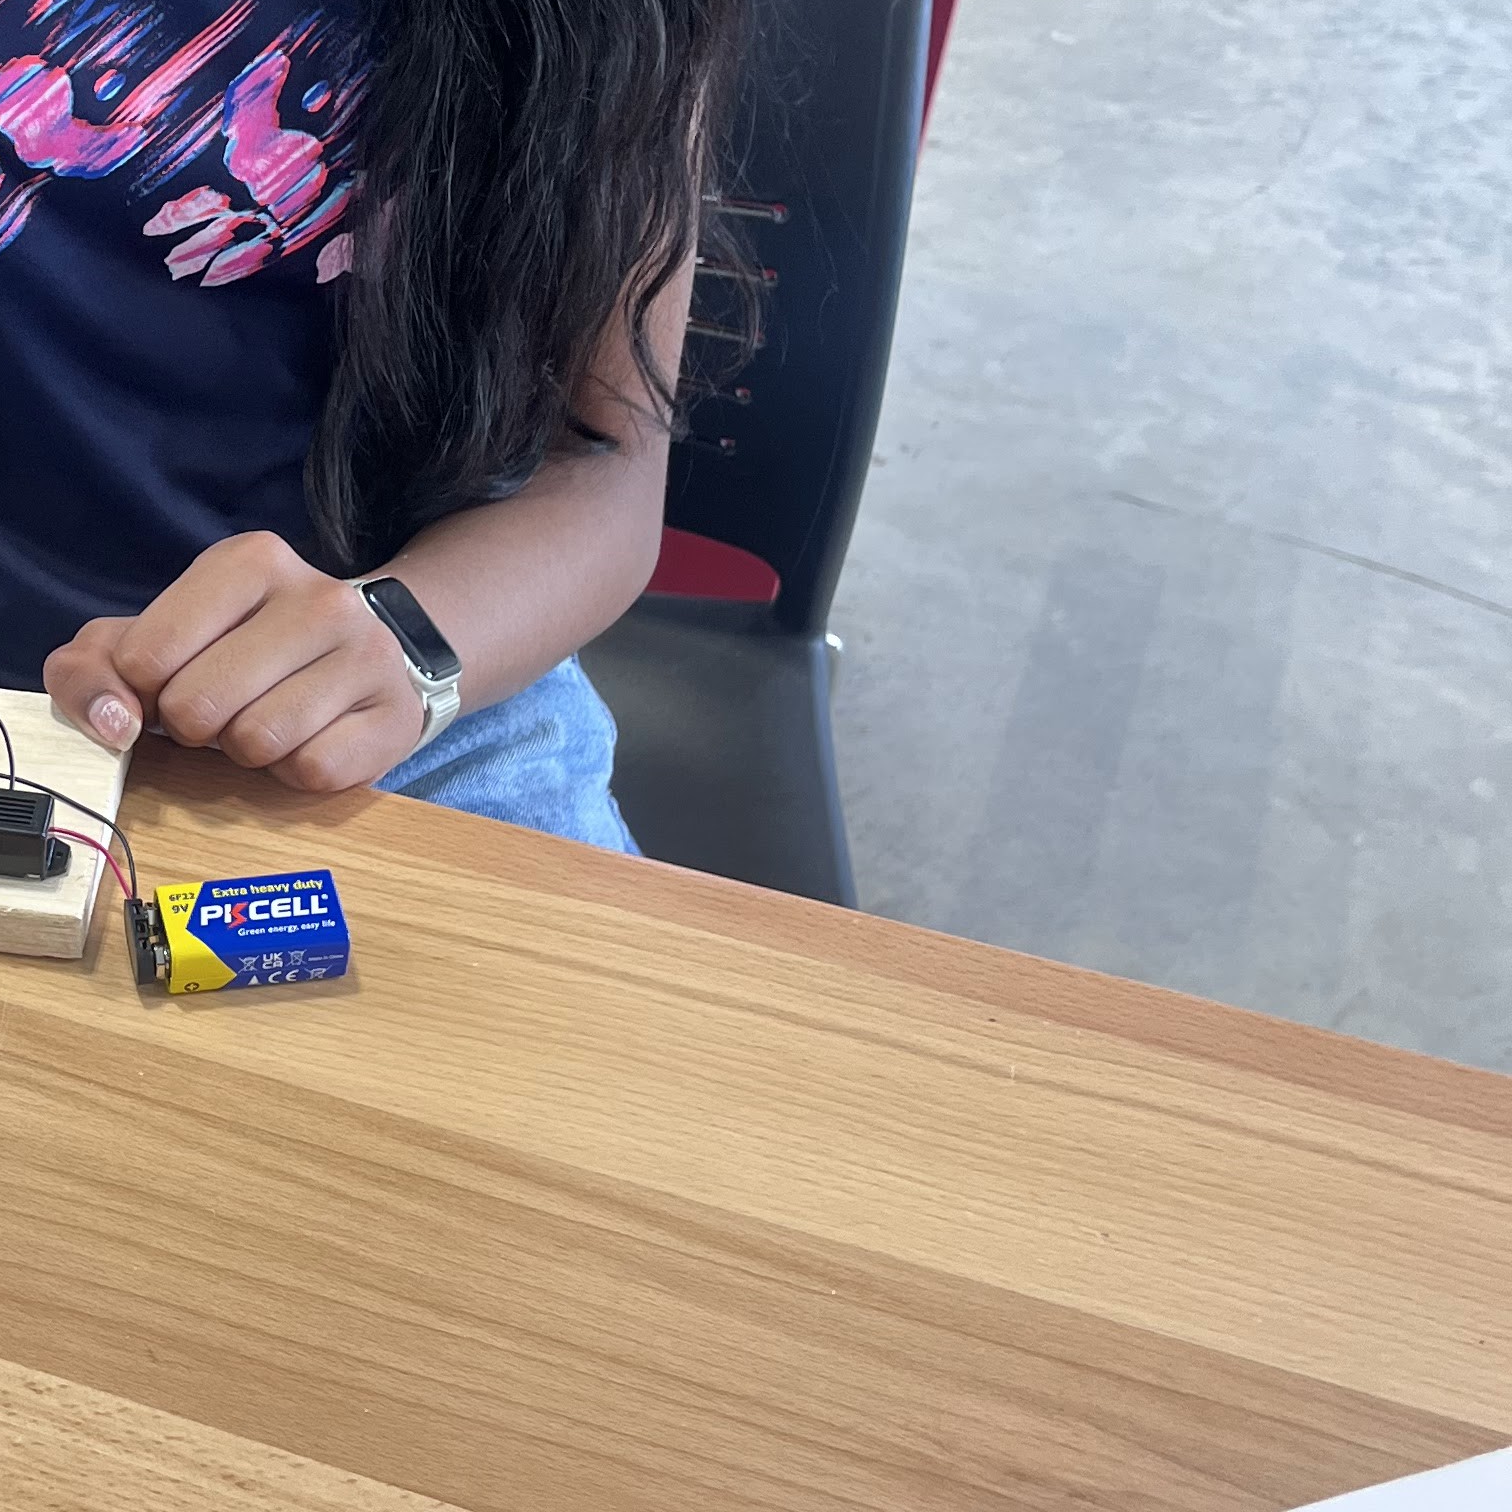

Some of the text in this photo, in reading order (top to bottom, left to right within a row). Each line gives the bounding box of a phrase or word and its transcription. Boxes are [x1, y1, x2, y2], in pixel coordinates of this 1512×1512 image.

[212, 879, 323, 898] Extra heavy duty
[168, 892, 195, 901] 6F22
[171, 904, 189, 914] 9V
[238, 927, 266, 937] Green
[301, 922, 320, 931] easy
[322, 919, 336, 928] life
[262, 951, 284, 962] UK
[262, 961, 284, 970] CA
